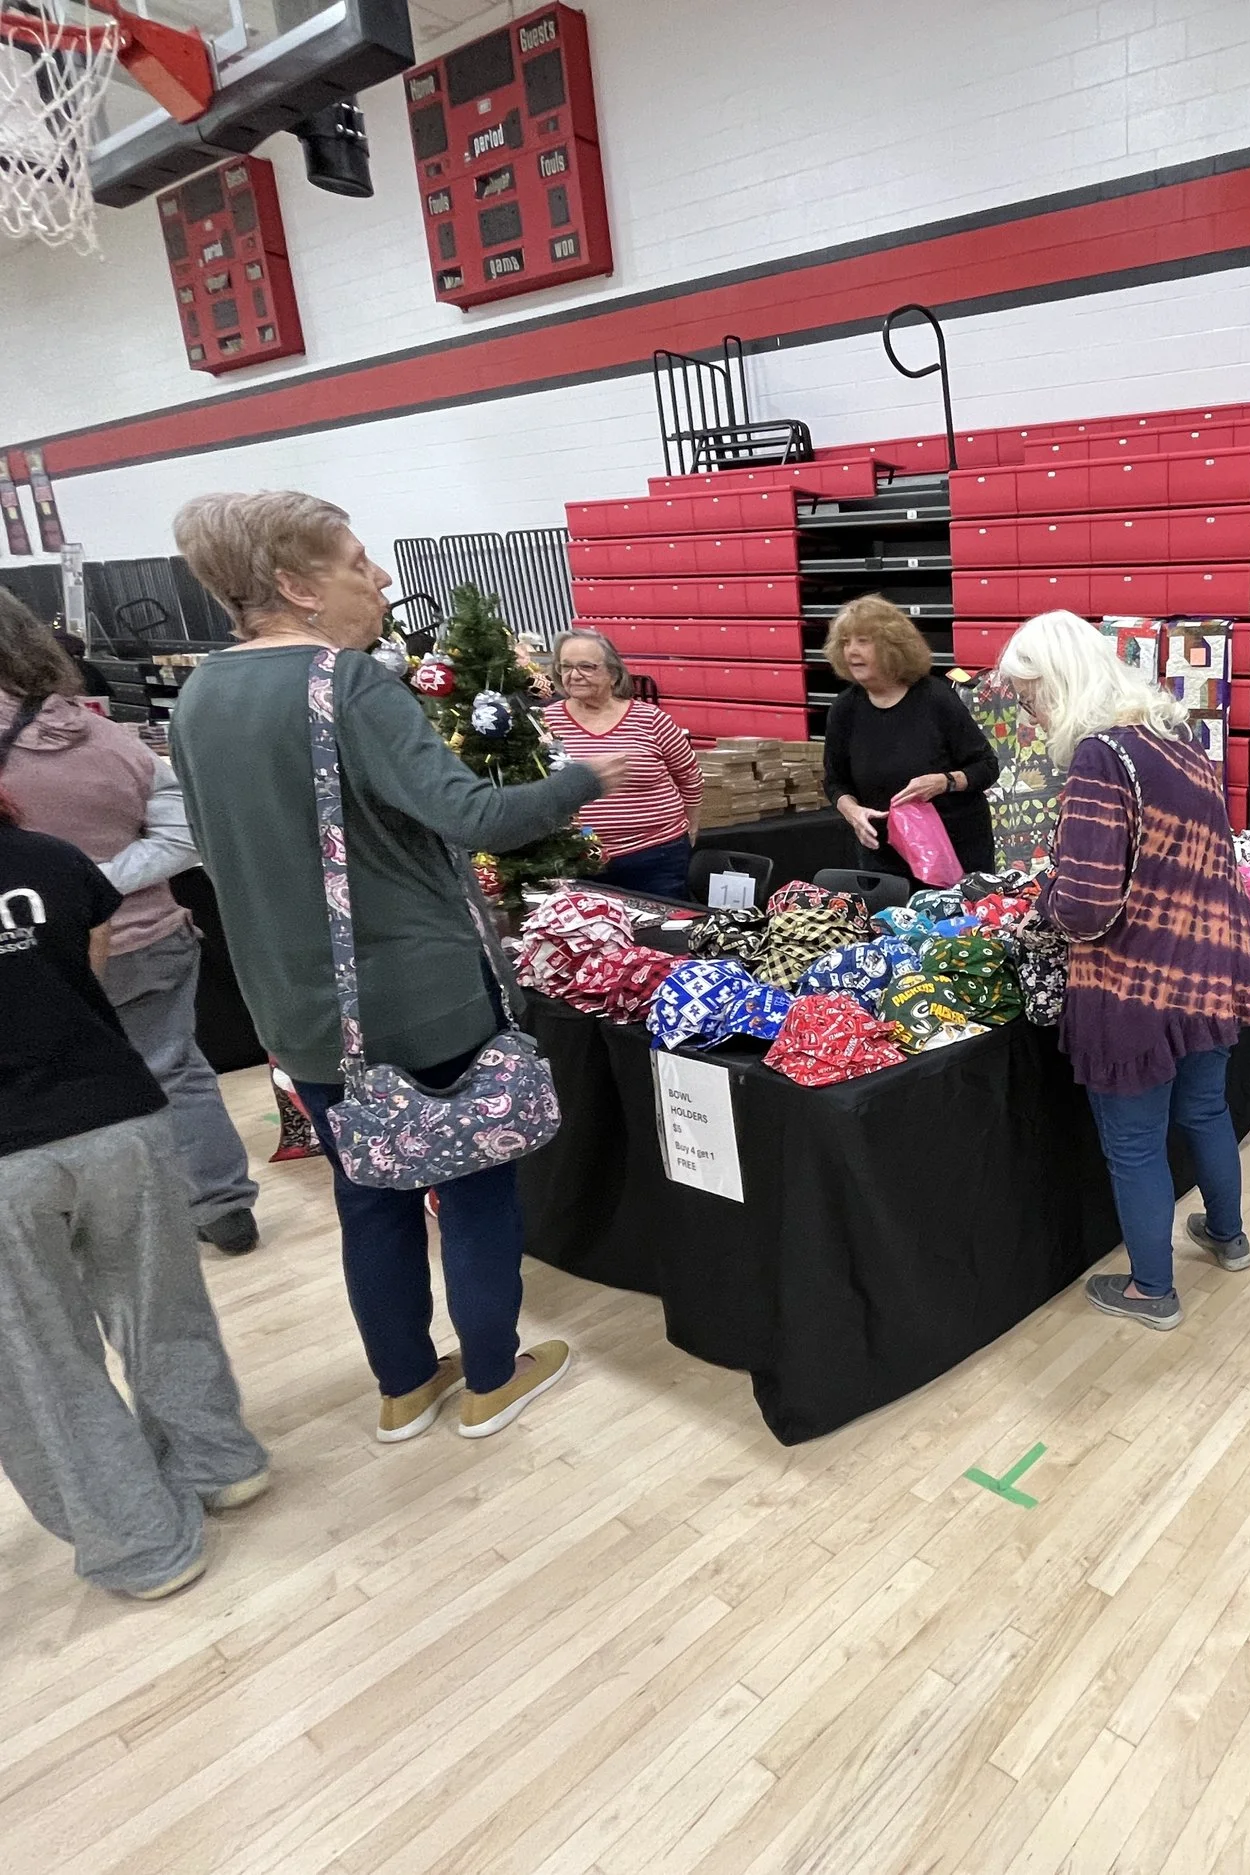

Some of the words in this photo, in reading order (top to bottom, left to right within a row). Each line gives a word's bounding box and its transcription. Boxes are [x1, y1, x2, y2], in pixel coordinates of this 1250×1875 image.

[520, 20, 556, 52] Guests
[473, 123, 505, 157] period
[540, 151, 565, 177] fouls
[428, 193, 450, 216] fouls
[553, 238, 575, 258] won
[891, 982, 935, 1007] PACKERS
[669, 1089, 692, 1103] BOWL
[670, 1106, 708, 1124] HOLDERS
[672, 1123, 682, 1134] $5
[675, 1141, 690, 1155] Buy
[690, 1147, 696, 1155] 4
[697, 1149, 709, 1159] get
[710, 1152, 715, 1160] 1
[677, 1157, 696, 1171] FREE
